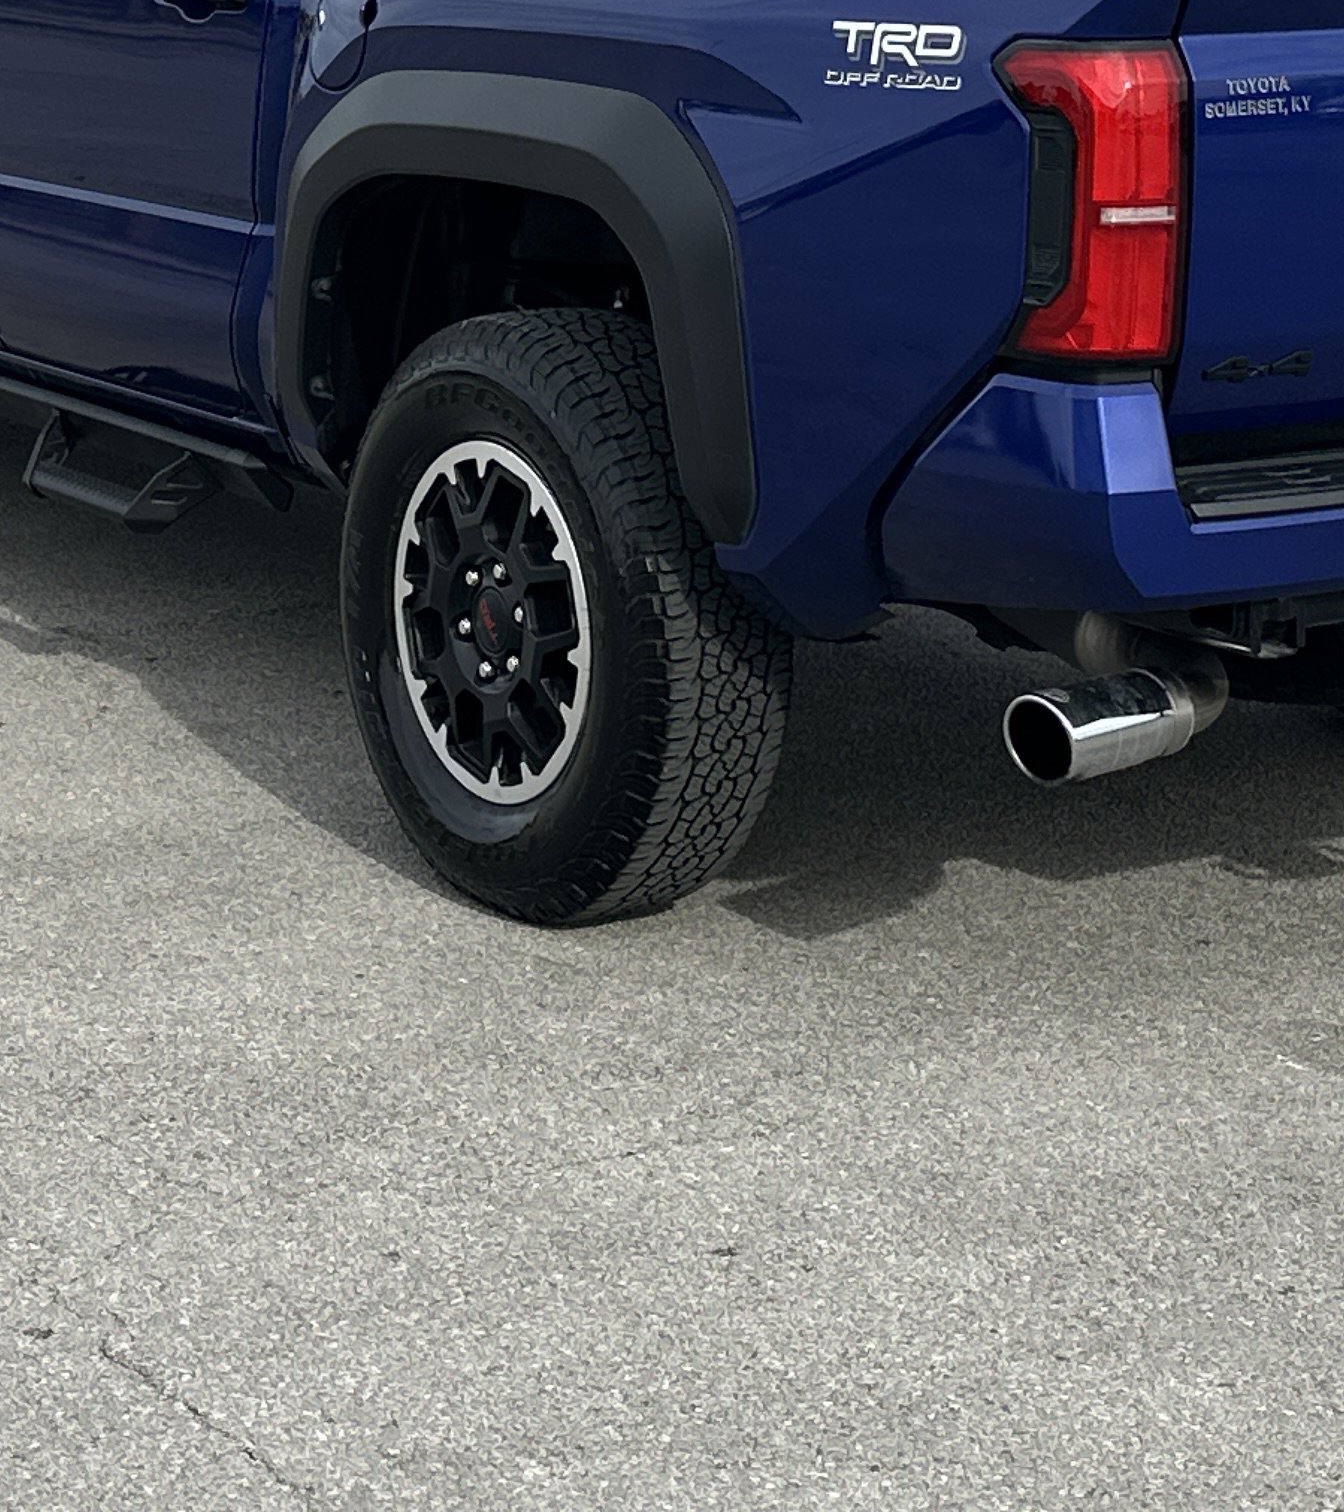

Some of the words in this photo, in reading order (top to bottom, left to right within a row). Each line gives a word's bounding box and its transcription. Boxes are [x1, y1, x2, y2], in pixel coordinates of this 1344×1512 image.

[832, 20, 965, 67] TRD
[824, 69, 880, 86] OFF
[883, 73, 962, 90] ROAD
[1226, 75, 1291, 95] TOYOTA
[1205, 97, 1288, 119] SOMERSET,
[1290, 95, 1312, 113] KY
